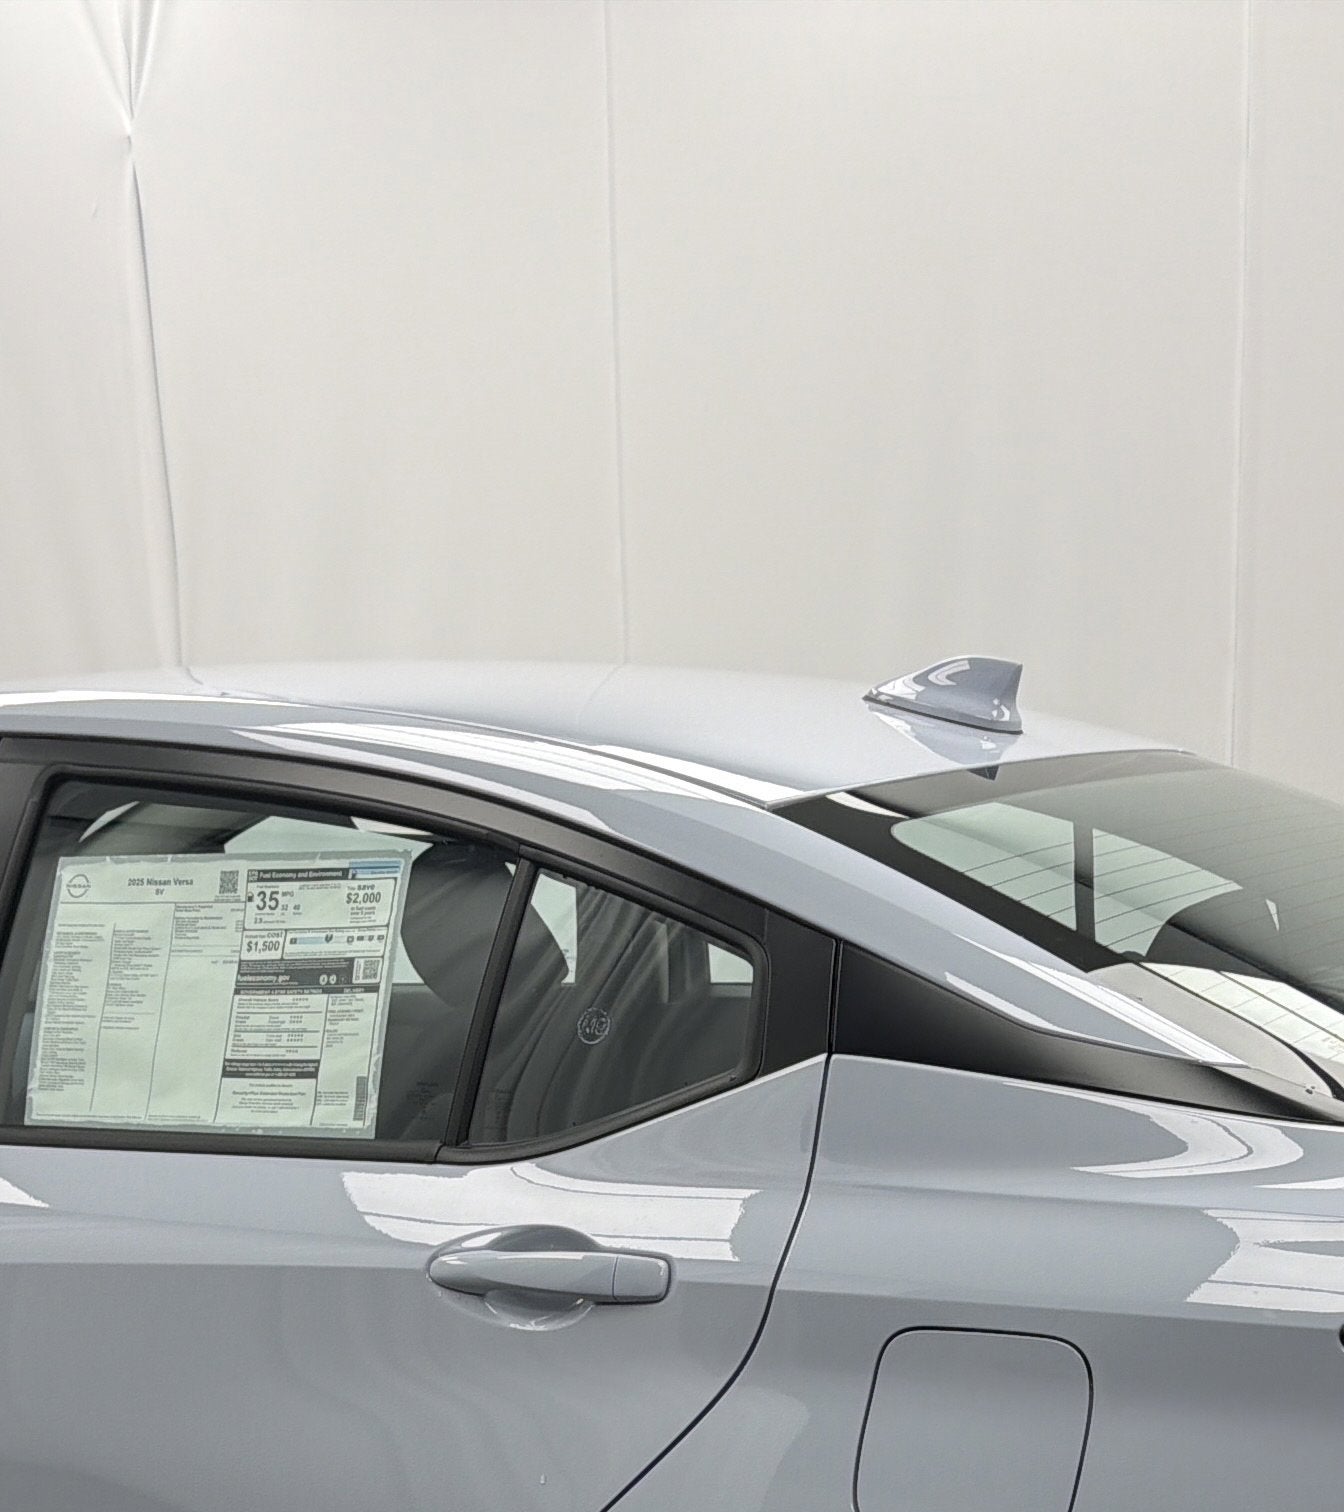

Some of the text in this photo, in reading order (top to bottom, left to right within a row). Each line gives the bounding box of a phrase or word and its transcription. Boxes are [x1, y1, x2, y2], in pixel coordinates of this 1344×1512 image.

[127, 877, 194, 887] 2025 Nissan Versa
[259, 871, 272, 879] Fuel
[272, 871, 297, 880] Economy
[308, 870, 343, 878] Environment
[256, 890, 279, 911] 35
[346, 891, 382, 905] $2,000
[246, 939, 281, 954] $1,500
